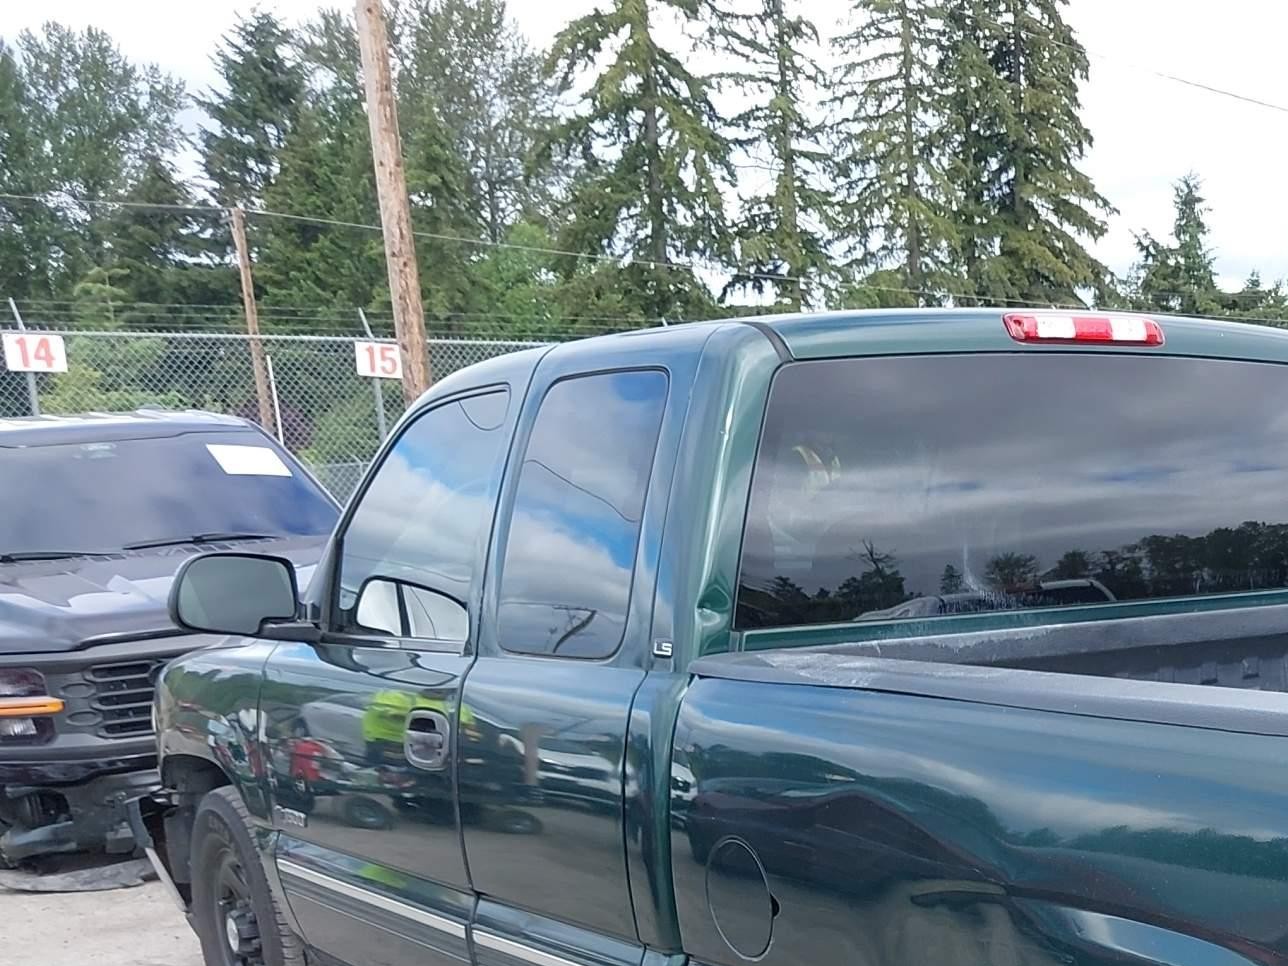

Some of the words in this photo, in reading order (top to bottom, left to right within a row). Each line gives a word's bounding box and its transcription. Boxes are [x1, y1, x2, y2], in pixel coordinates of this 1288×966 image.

[15, 337, 56, 369] 14
[365, 346, 398, 375] 15
[653, 640, 673, 656] LS
